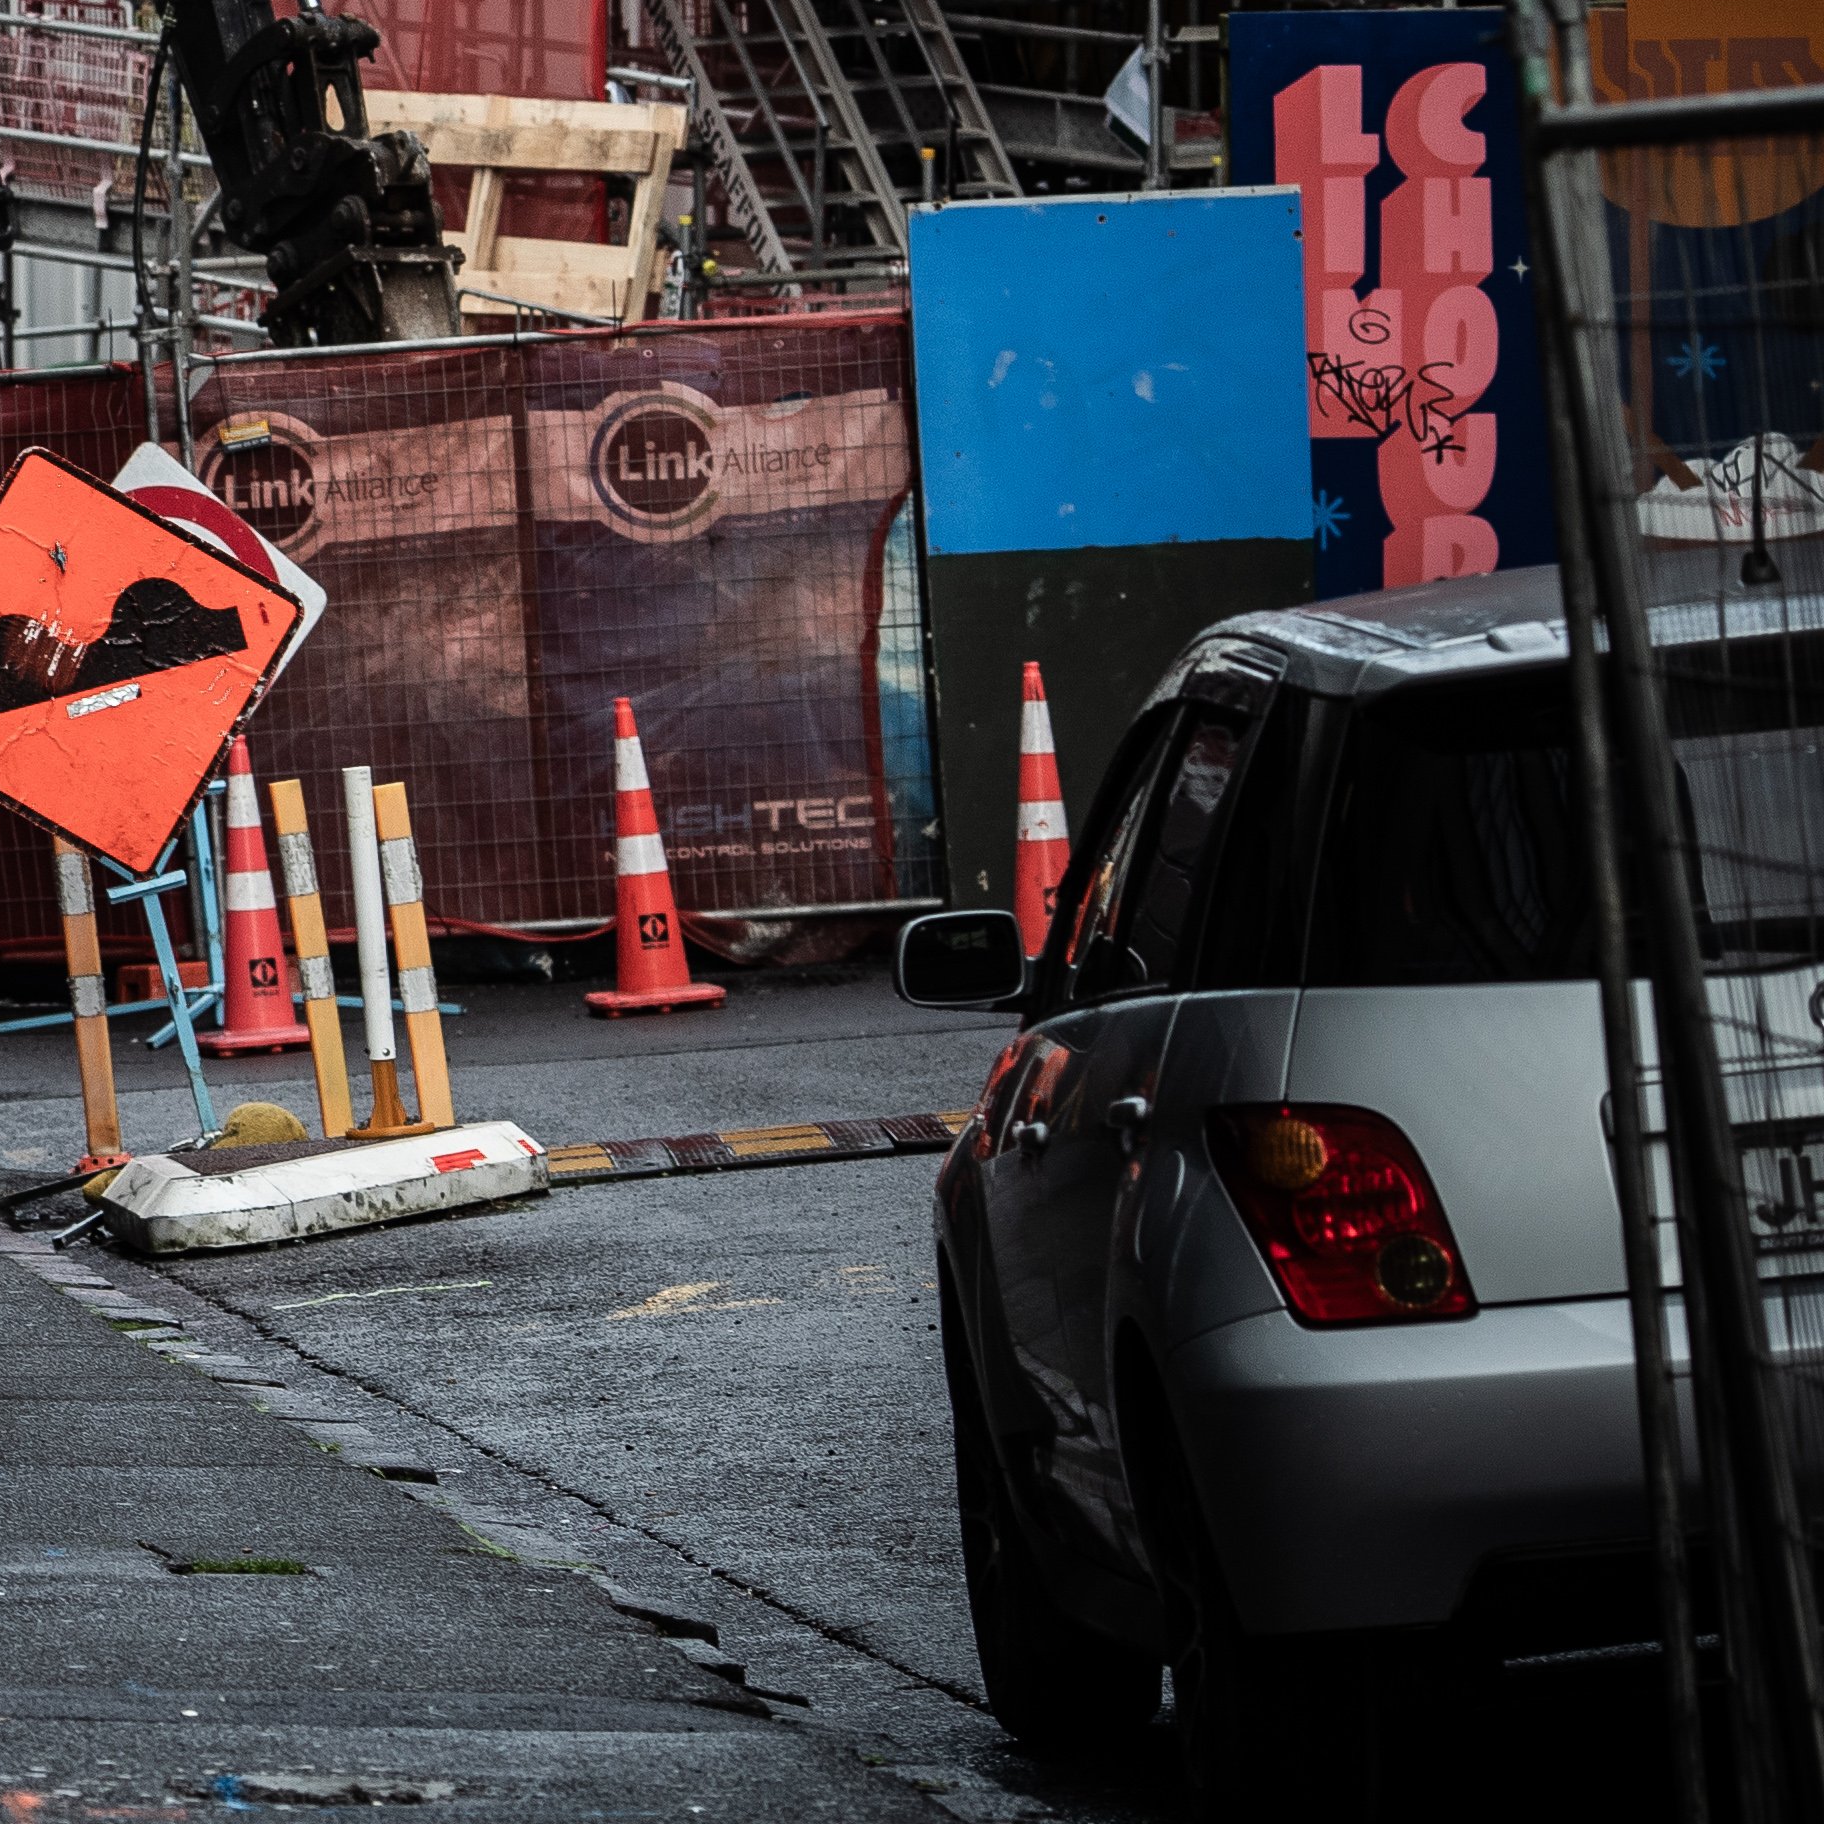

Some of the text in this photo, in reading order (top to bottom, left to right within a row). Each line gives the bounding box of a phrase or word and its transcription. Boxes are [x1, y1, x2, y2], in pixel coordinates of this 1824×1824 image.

[619, 440, 831, 481] Link Alliance
[224, 468, 439, 510] Link Alliance
[761, 836, 872, 856] SOLUTIONS
